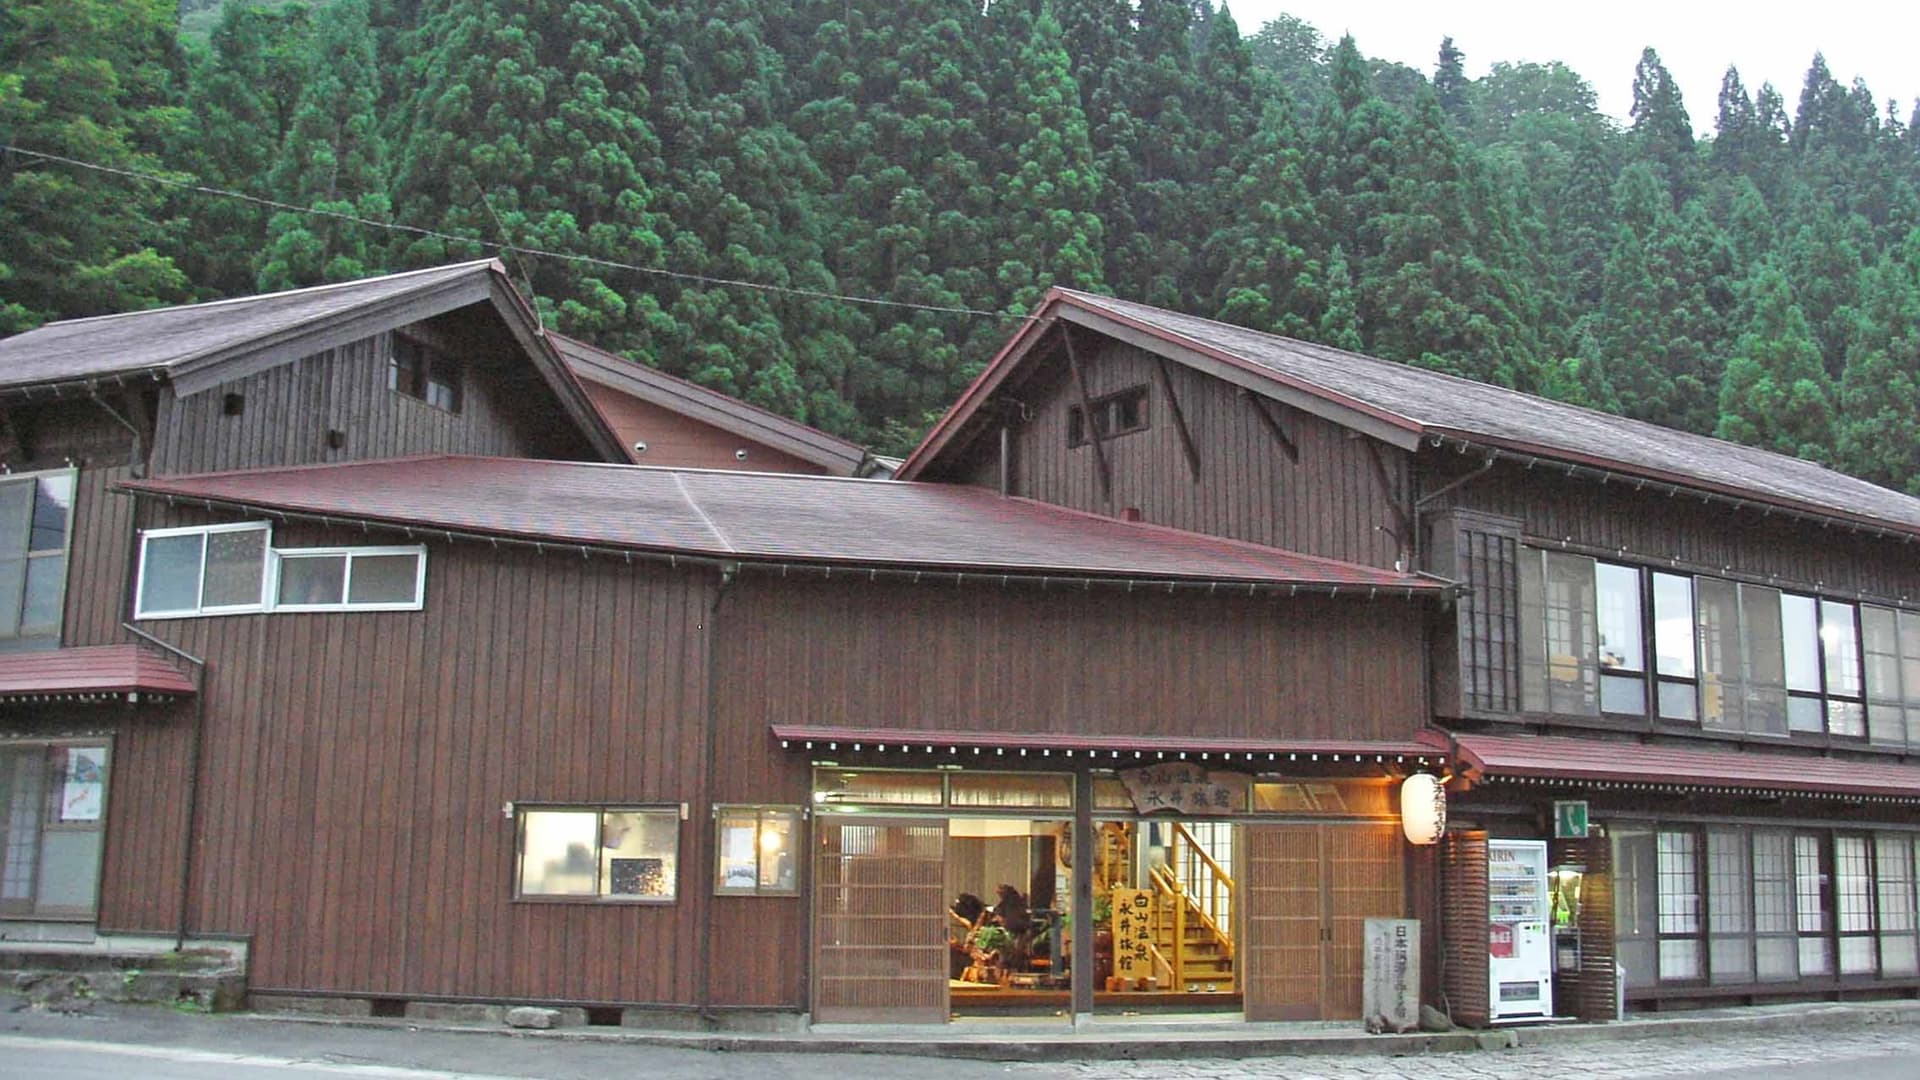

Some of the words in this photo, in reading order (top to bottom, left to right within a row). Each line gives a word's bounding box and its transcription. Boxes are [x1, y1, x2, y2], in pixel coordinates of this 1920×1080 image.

[1119, 898, 1134, 970] 永井旅館
[1134, 892, 1149, 961] 白山温泉
